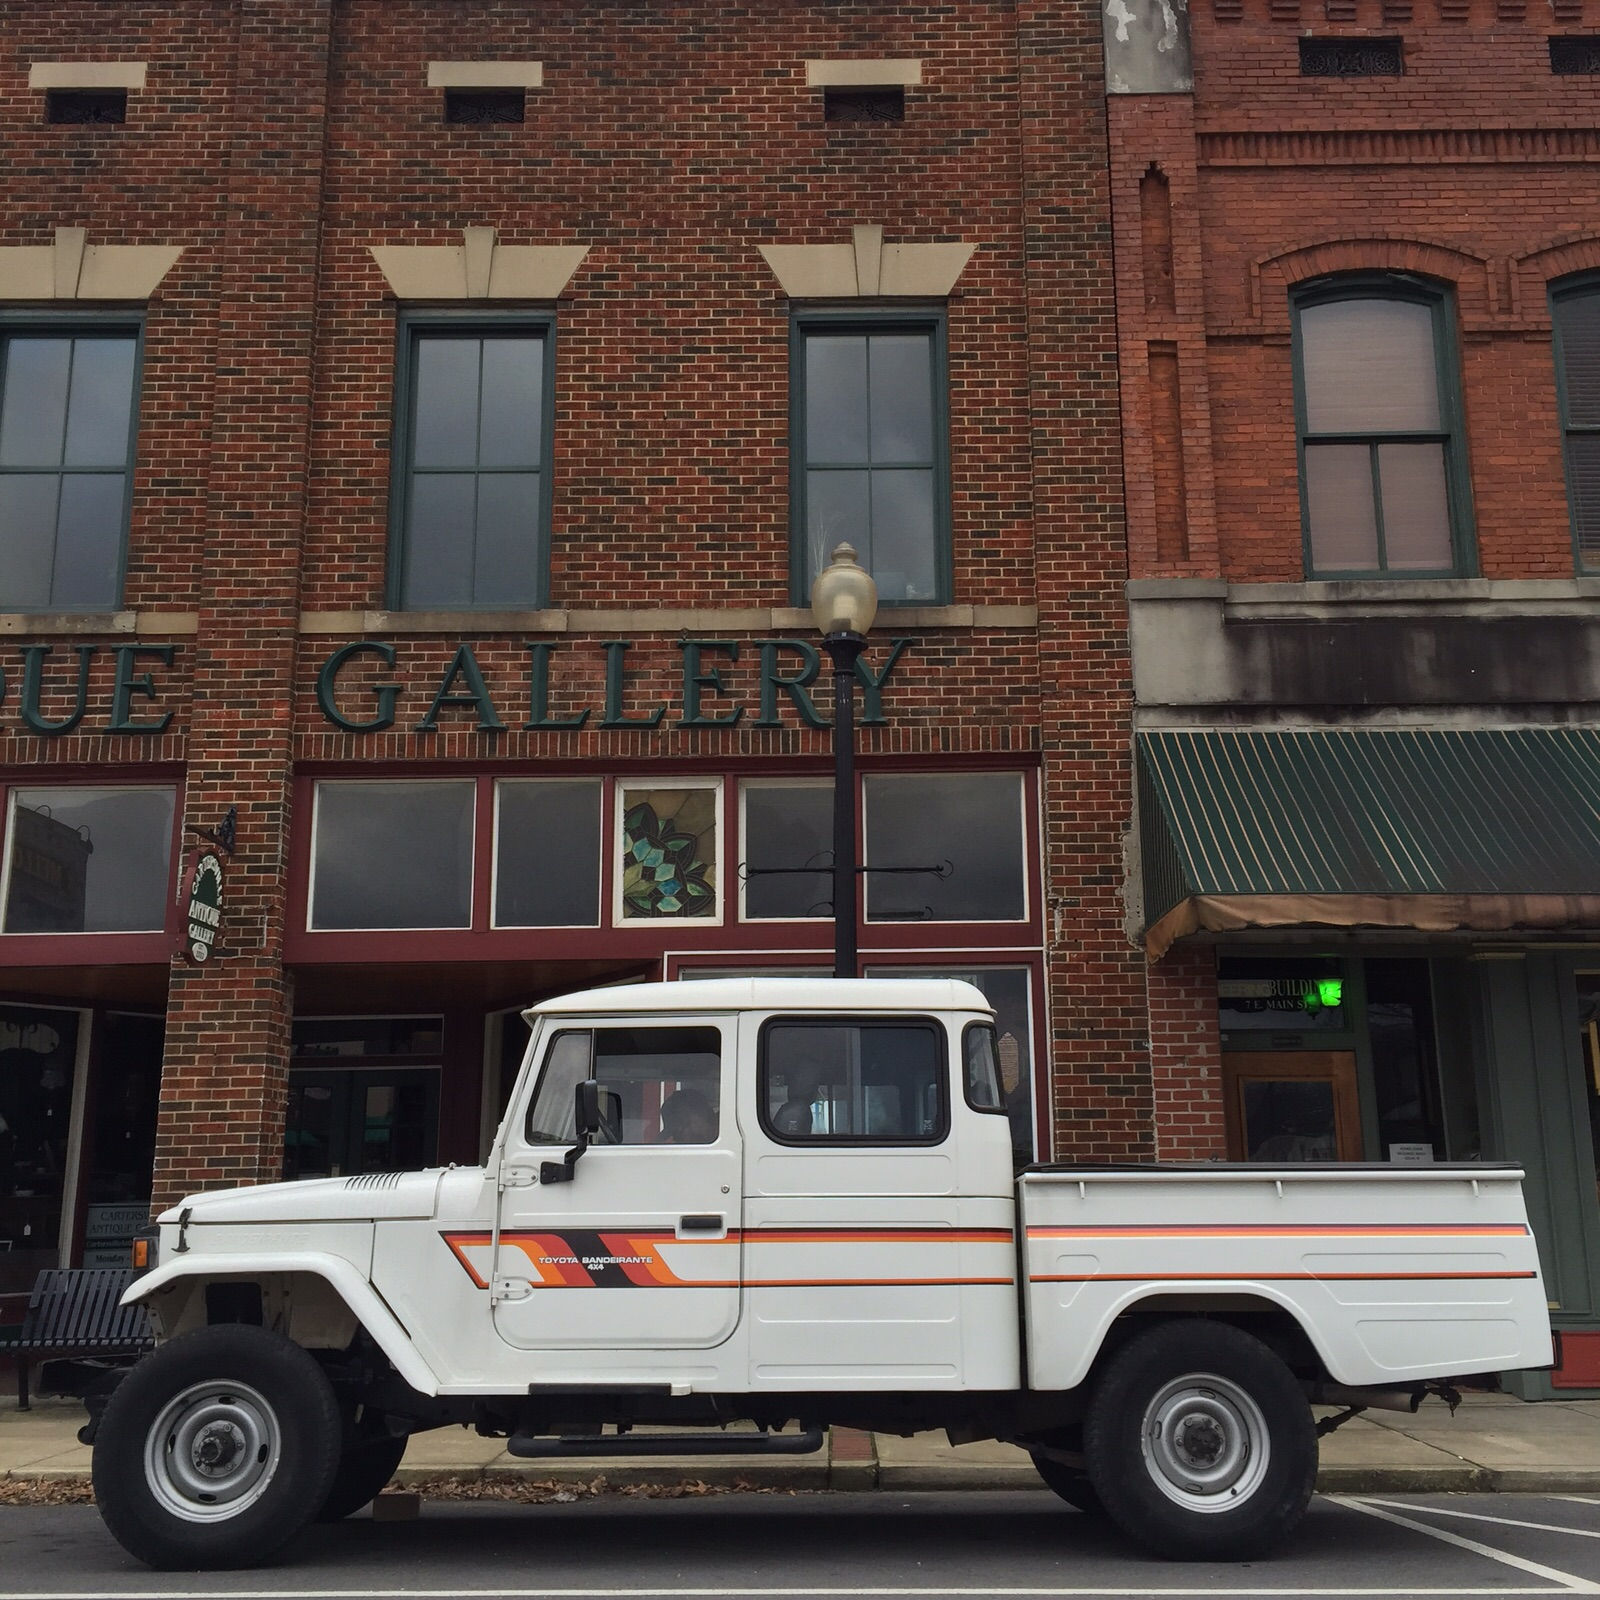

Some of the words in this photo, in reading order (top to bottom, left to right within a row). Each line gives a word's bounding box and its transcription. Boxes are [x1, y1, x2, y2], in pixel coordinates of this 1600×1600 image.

[0, 643, 175, 736] UE
[317, 637, 914, 733] GALLERY
[188, 898, 221, 928] ANTIQUE
[1266, 999, 1294, 1009] MAIN
[90, 1223, 132, 1234] ANTIQUE
[96, 1254, 124, 1264] Monday
[538, 1256, 579, 1264] TOYOTA
[582, 1256, 653, 1264] BANDEIRANTE
